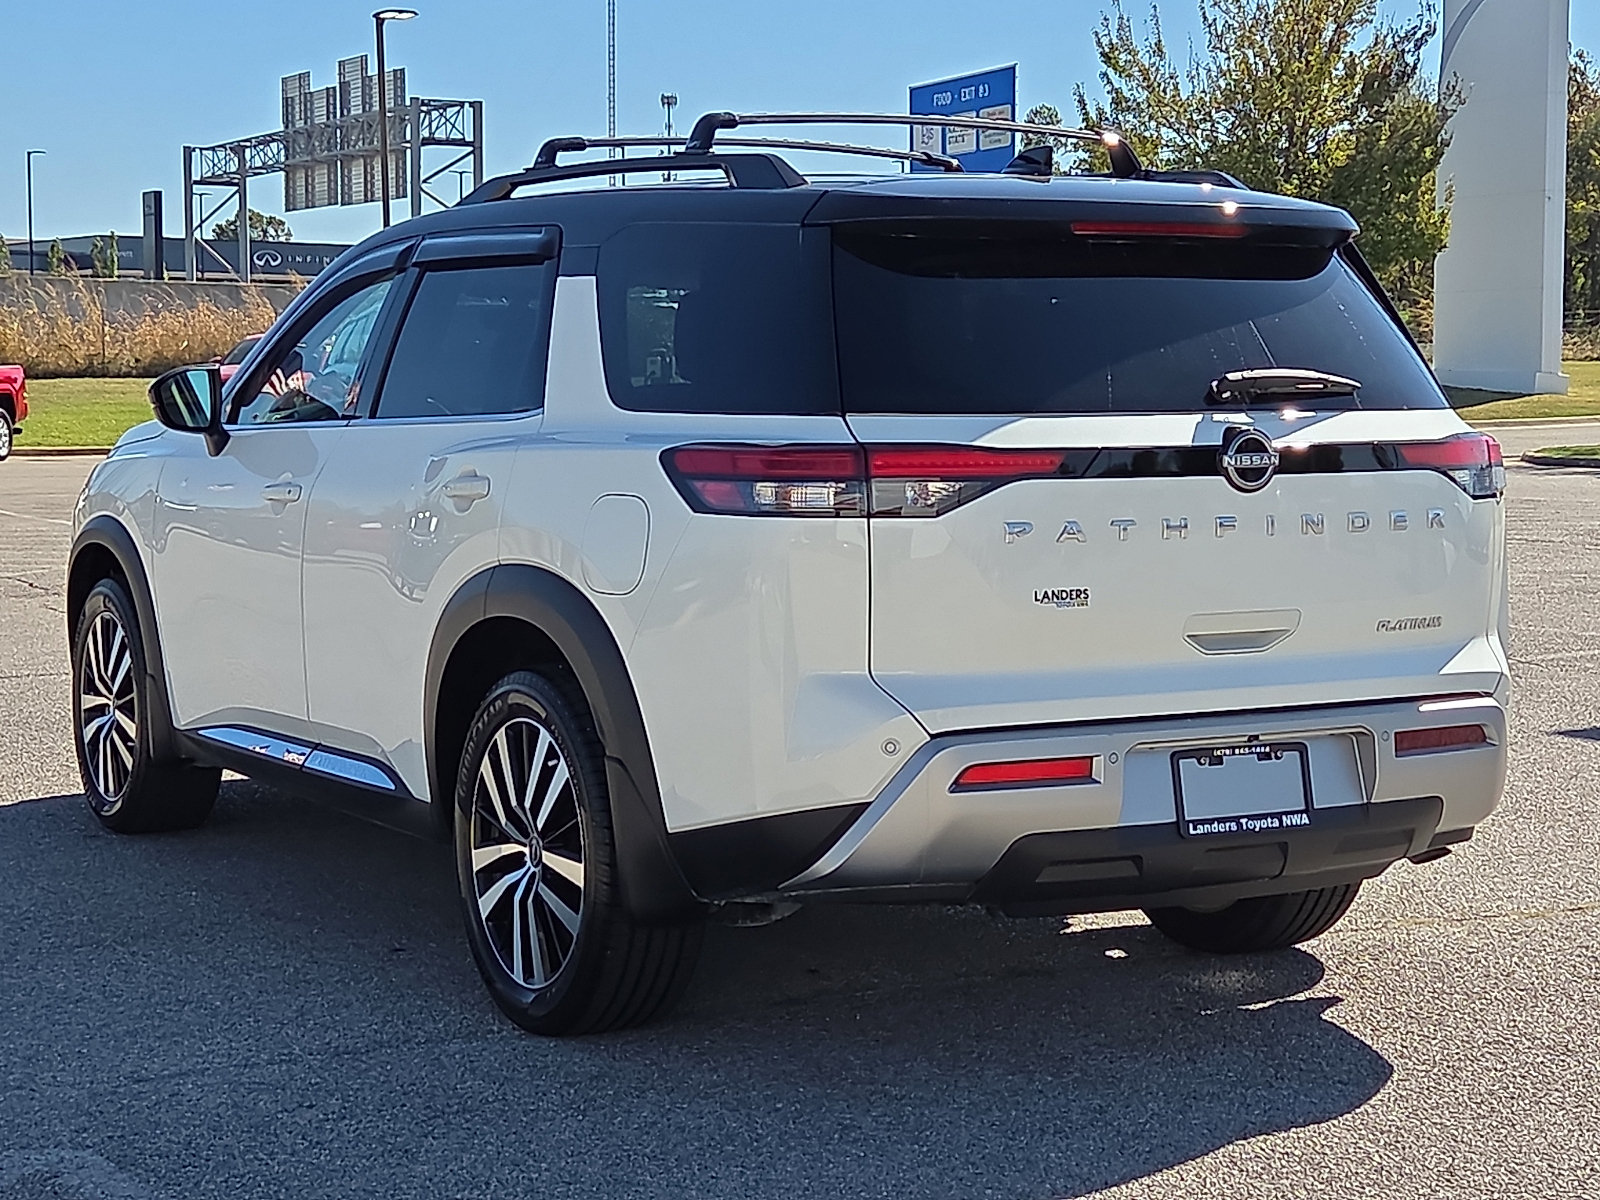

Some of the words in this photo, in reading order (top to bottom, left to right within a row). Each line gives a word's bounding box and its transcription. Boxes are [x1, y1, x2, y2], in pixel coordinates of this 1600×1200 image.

[287, 255, 338, 264] INFIN
[1223, 453, 1280, 468] NISSAN
[1003, 506, 1446, 545] PATHFINDER
[1034, 588, 1090, 604] LANDERS
[1188, 821, 1238, 835] Landers
[1240, 816, 1280, 832] Toyota
[1282, 813, 1310, 828] NWA
